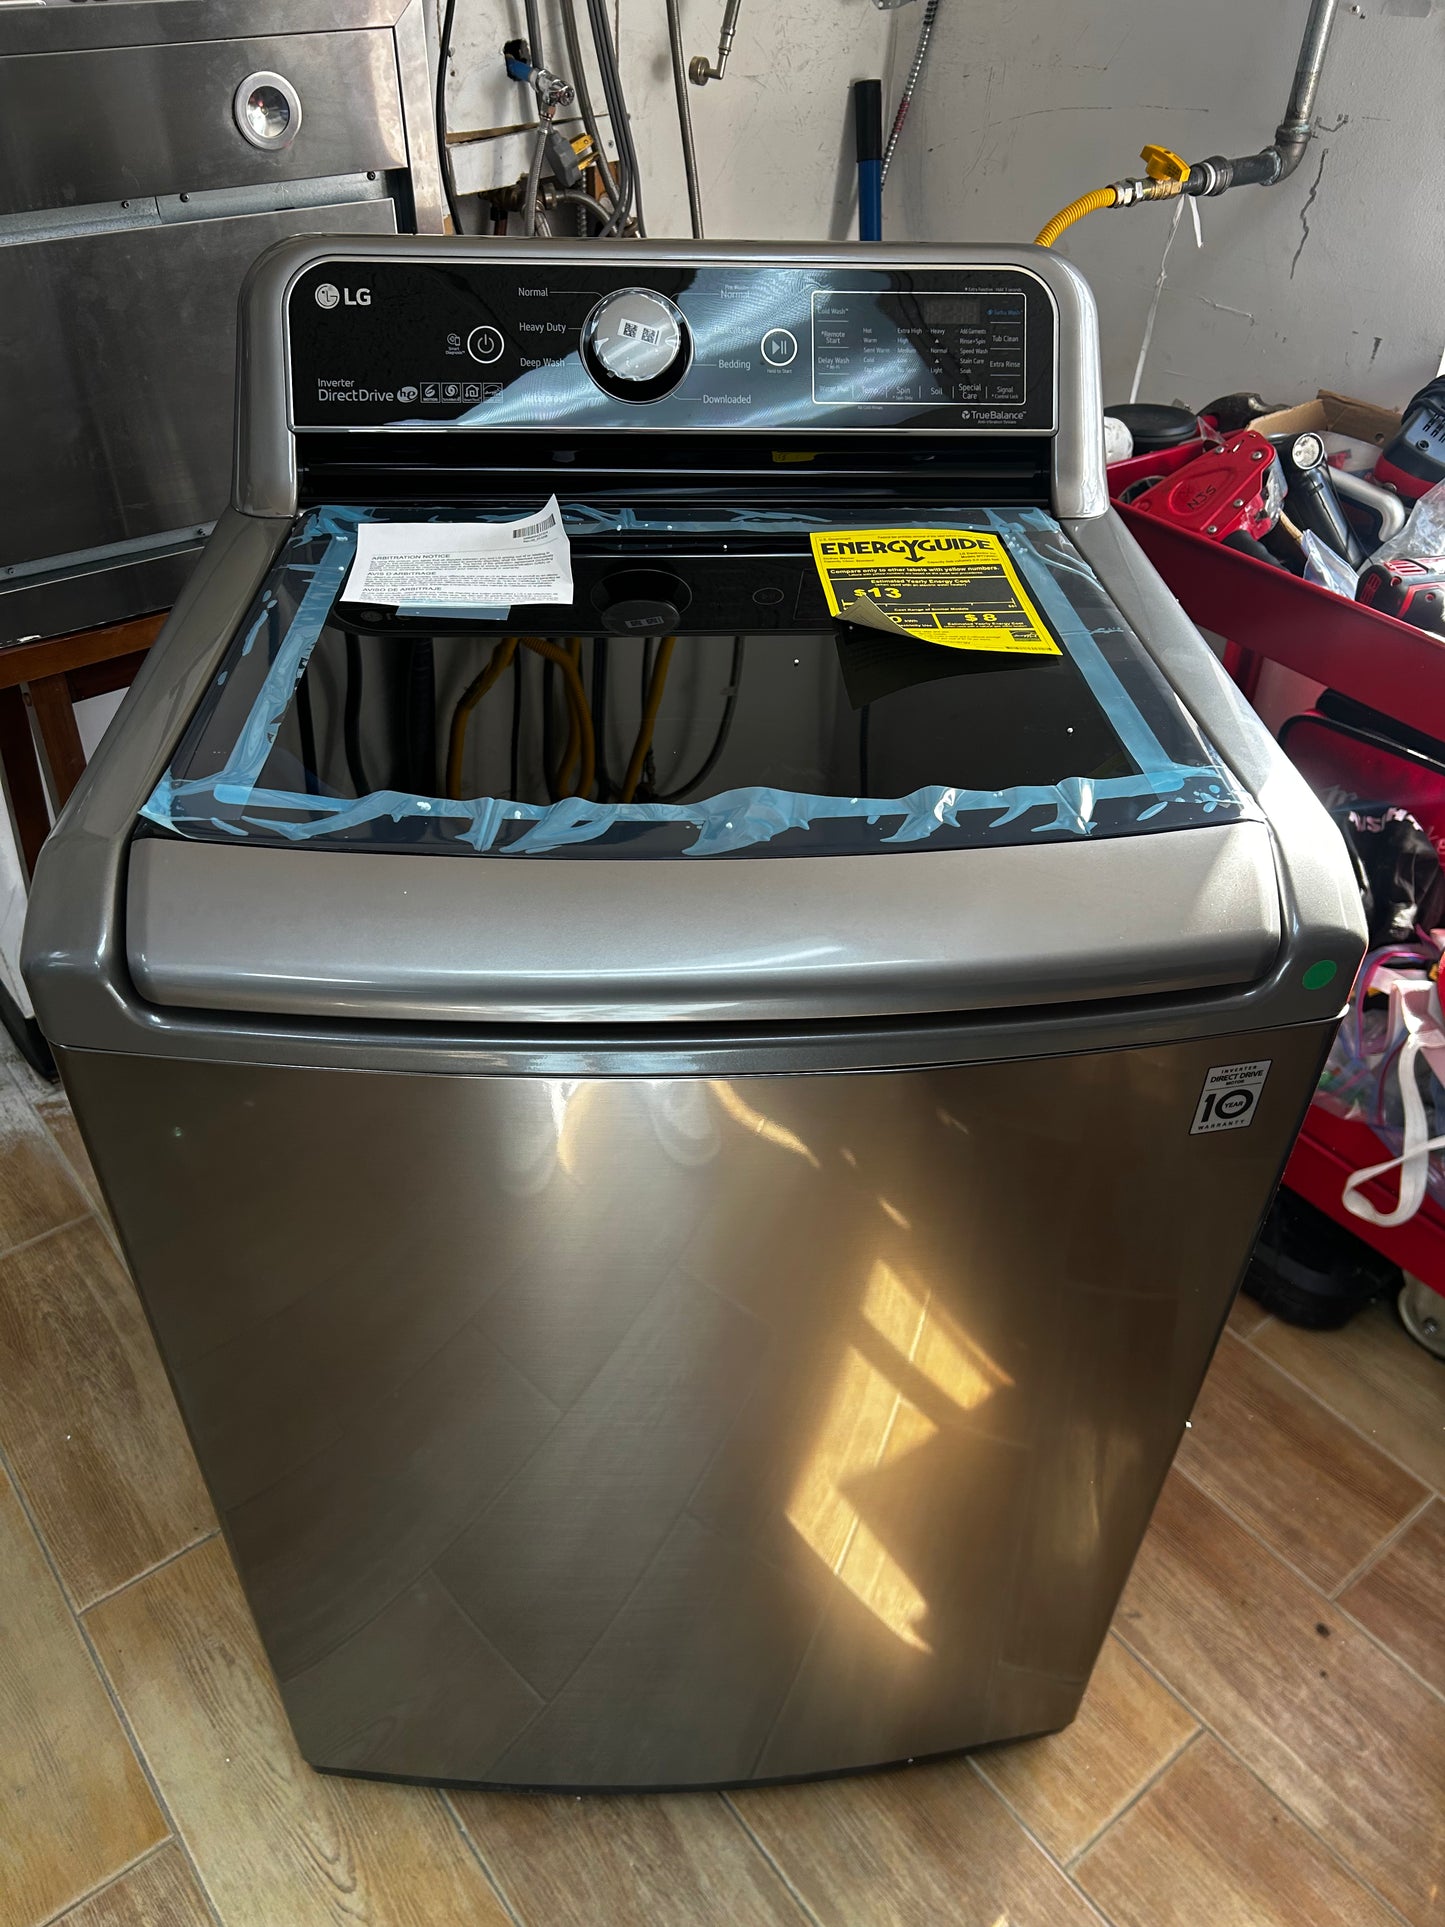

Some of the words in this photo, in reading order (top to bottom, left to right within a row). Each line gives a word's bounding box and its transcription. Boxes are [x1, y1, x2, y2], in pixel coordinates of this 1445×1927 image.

[344, 287, 372, 306] LG
[518, 287, 548, 297] Normal
[720, 290, 750, 299] Normal
[519, 322, 545, 334] Heavy
[546, 322, 567, 334] Duty
[930, 328, 946, 336] Heavy
[520, 357, 541, 369] Deep
[543, 358, 565, 367] Wash
[719, 359, 751, 371] Bedding
[989, 360, 1005, 368] Extra
[1005, 360, 1021, 368] Rinse
[930, 367, 943, 375] Light
[317, 378, 355, 387] Inverter
[896, 385, 911, 395] Spin
[930, 387, 943, 395] Soil
[958, 383, 982, 392] Special
[996, 386, 1014, 395] Signal
[703, 394, 752, 404] Downloaded
[962, 391, 978, 400] Care
[820, 539, 995, 562] ENERGYGUIDE
[1221, 1065, 1257, 1074] INVERTER
[1210, 1073, 1240, 1083] DIRECT
[1240, 1070, 1264, 1079] DRIVE
[1200, 1089, 1254, 1123] 10
[1224, 1101, 1244, 1109] YEAR
[1198, 1120, 1245, 1130] WARRANTY
